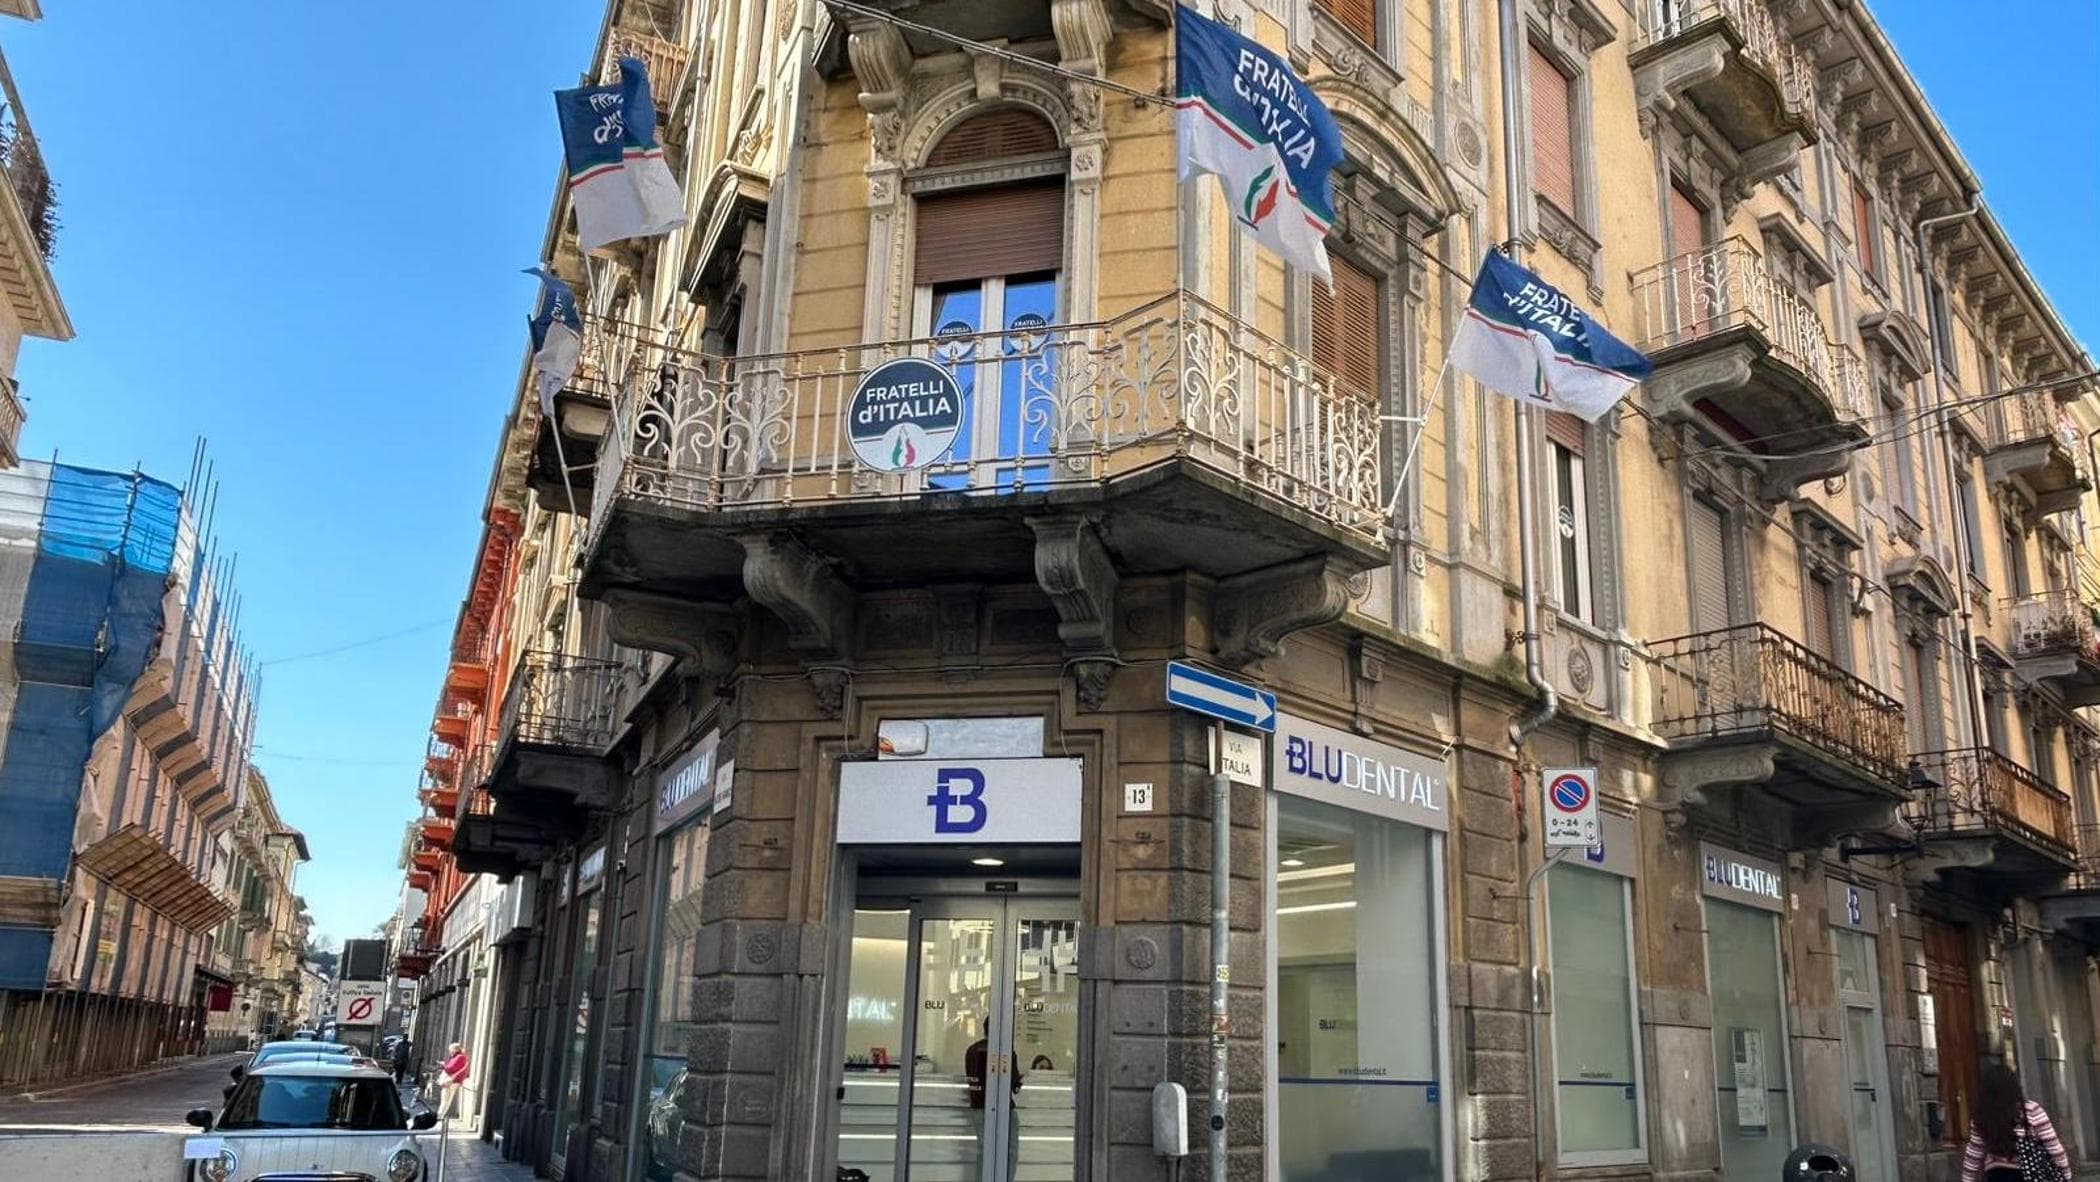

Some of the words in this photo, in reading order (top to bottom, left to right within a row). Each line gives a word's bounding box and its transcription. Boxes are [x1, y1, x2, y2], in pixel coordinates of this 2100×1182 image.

[866, 380, 944, 402] FRATELLI
[858, 397, 952, 424] d'ITALIA
[1222, 757, 1252, 776] TALIA
[1286, 735, 1440, 811] BLUDENTAL
[1705, 855, 1783, 899] BLUDENTAL
